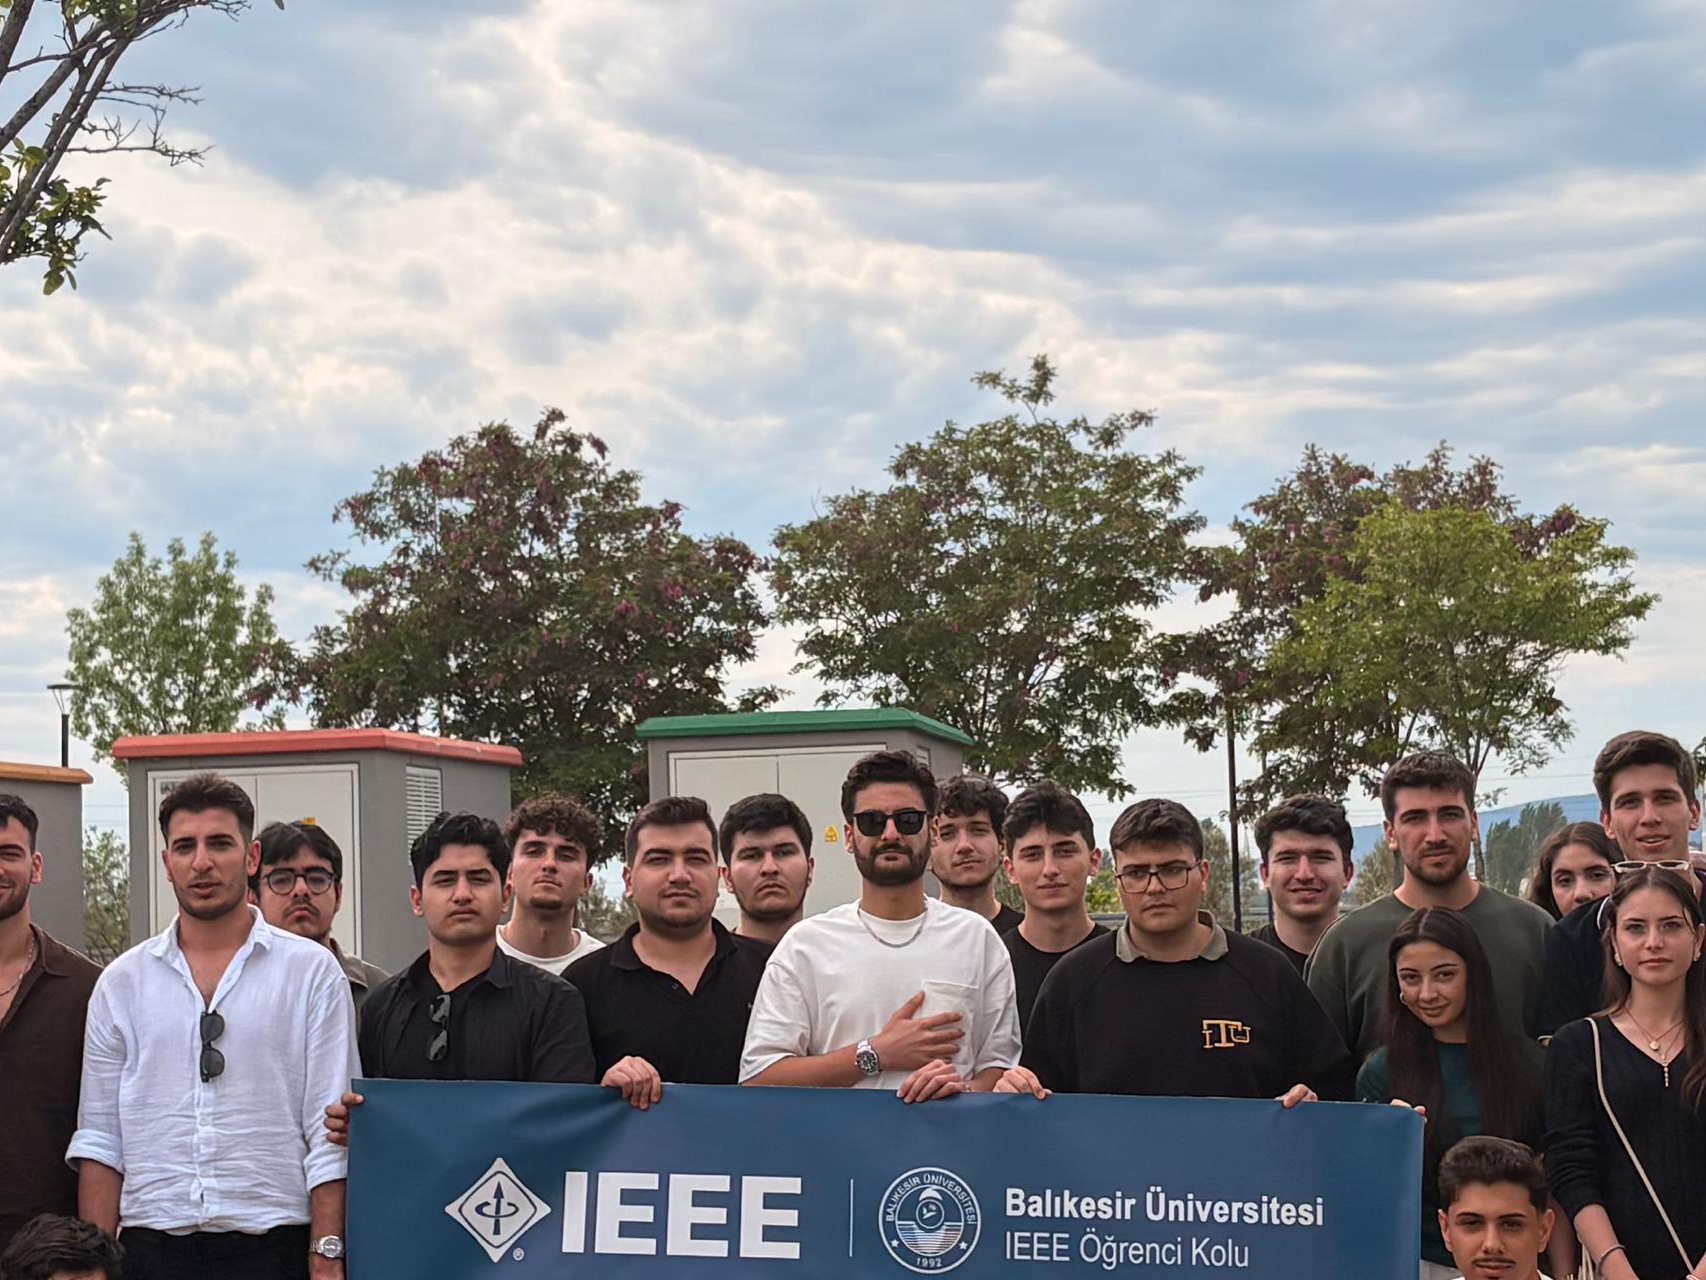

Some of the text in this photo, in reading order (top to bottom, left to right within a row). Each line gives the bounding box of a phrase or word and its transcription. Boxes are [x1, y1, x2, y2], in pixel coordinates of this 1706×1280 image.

[562, 1171, 802, 1259] IEEE
[1006, 1186, 1323, 1226] Balıkesir Üniversitesi
[916, 1257, 943, 1268] 1992
[1006, 1228, 1249, 1270] IEEE Öğrenci Kolu
